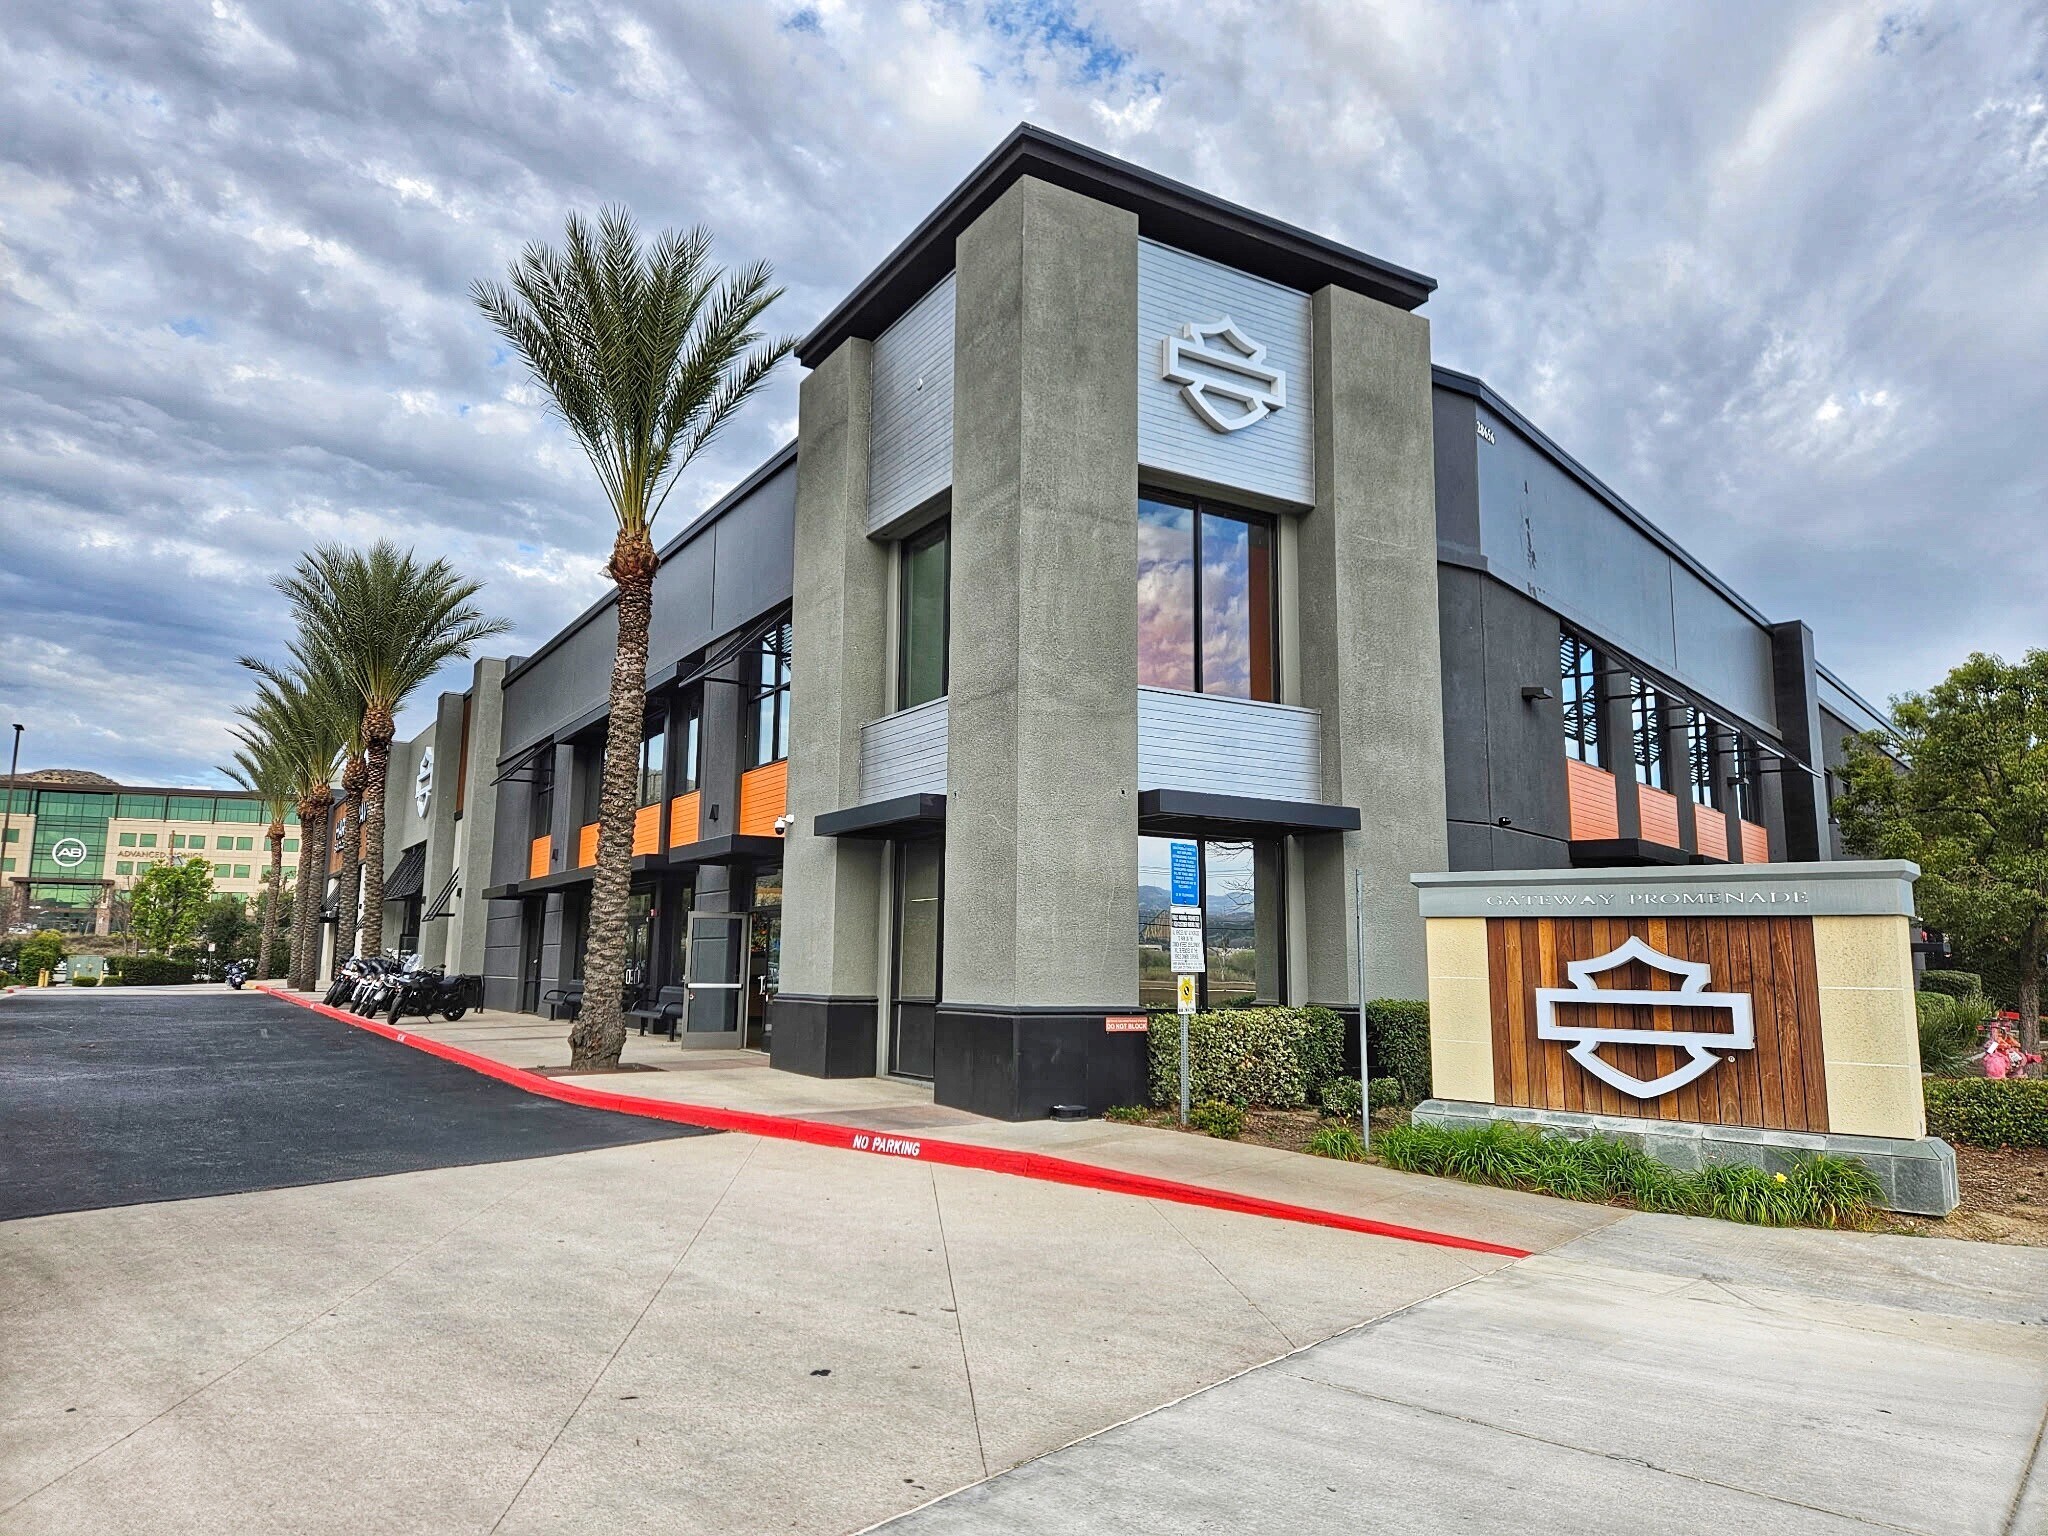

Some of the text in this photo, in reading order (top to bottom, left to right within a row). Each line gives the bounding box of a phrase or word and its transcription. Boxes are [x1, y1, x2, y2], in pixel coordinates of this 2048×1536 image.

[57, 848, 82, 858] AB
[117, 850, 166, 859] ADVANCED
[1486, 891, 1809, 905] GATEWAY PROMENADE
[852, 1134, 921, 1157] NO PARKING
